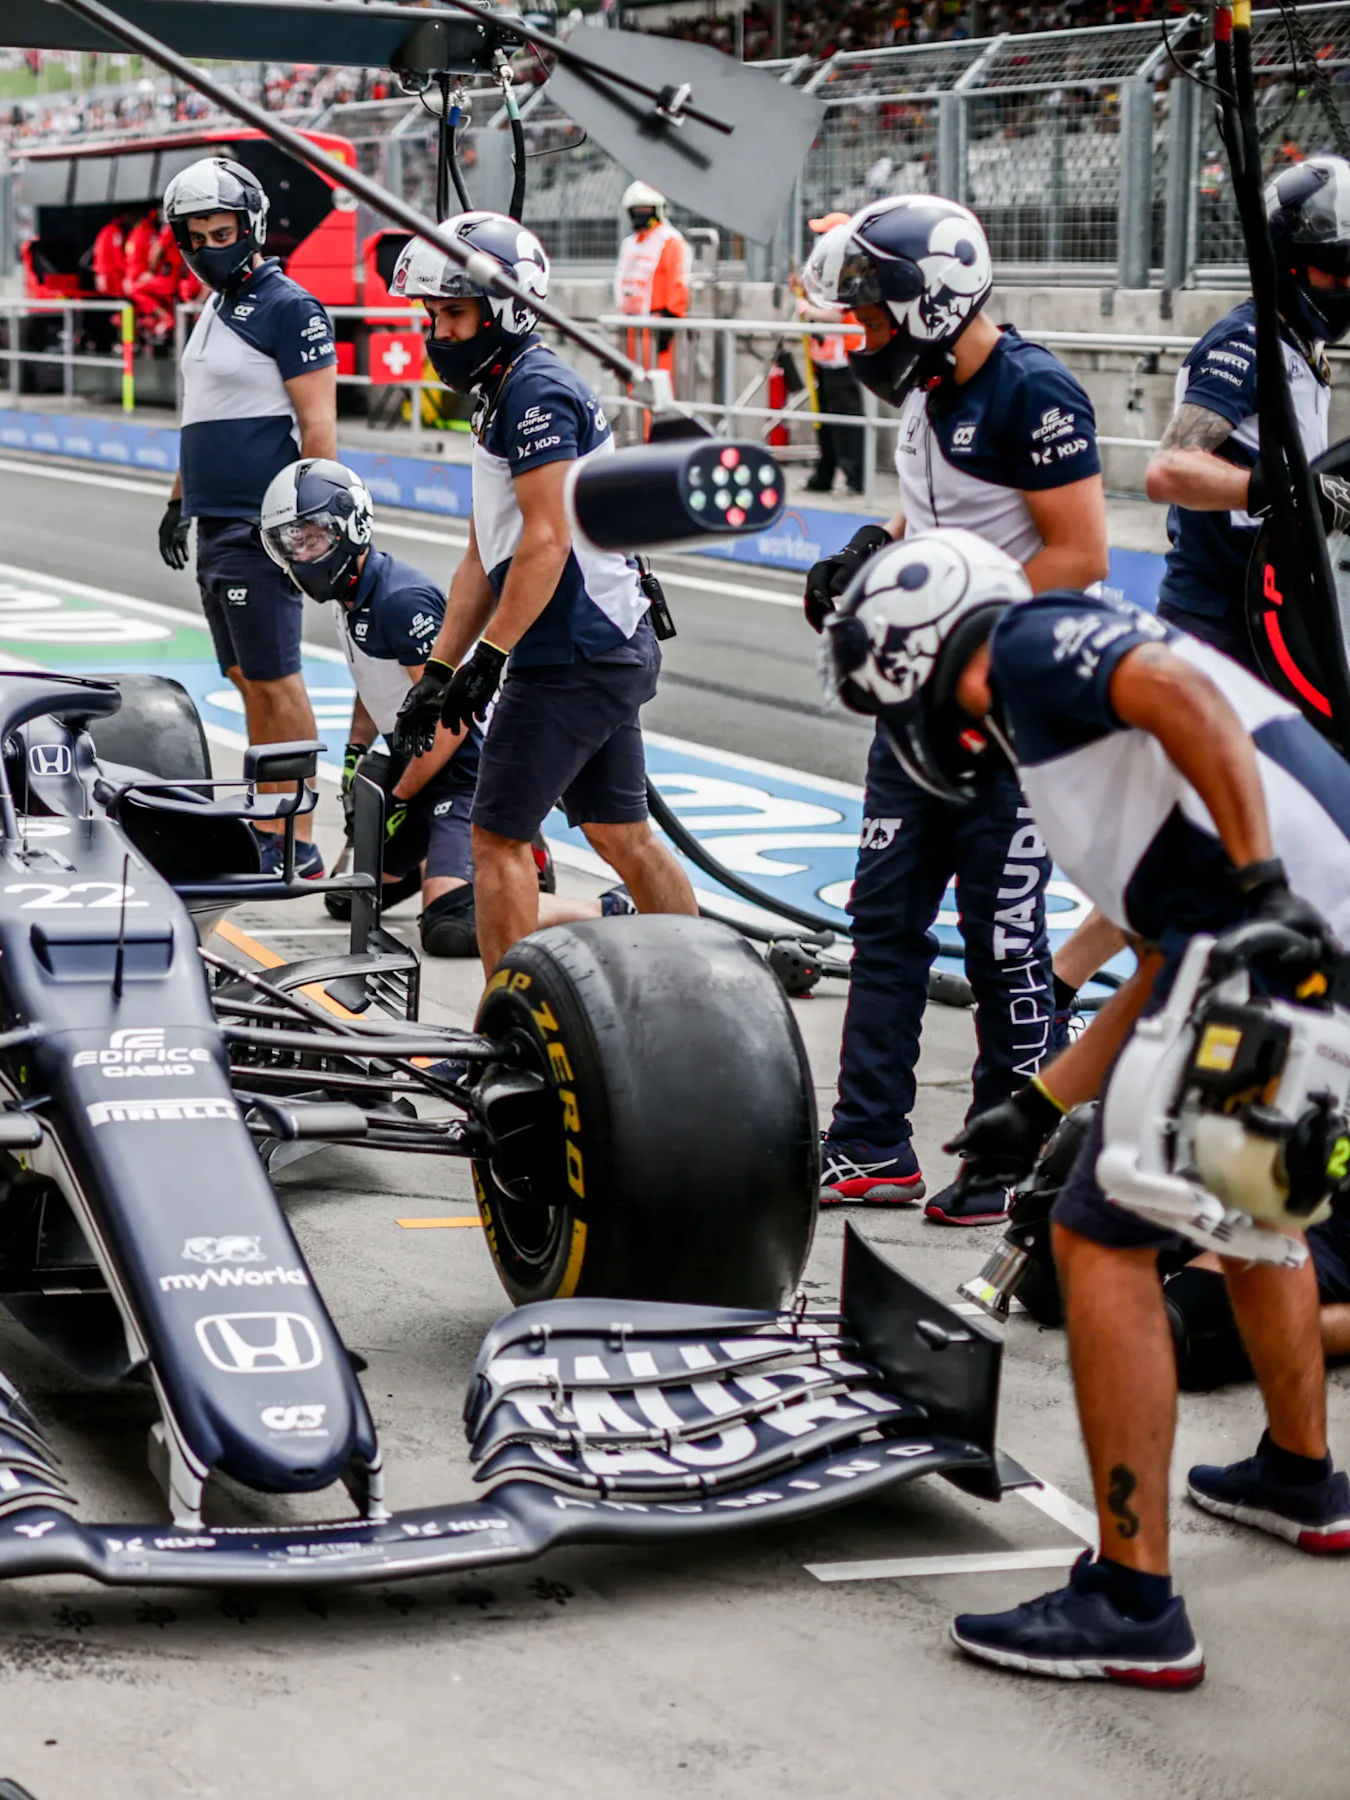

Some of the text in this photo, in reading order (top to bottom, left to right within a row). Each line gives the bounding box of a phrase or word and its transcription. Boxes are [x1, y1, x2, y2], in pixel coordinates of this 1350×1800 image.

[1207, 349, 1250, 372] PIRELLI
[517, 411, 552, 431] EDIFICE
[522, 421, 550, 436] CASIO
[1032, 412, 1075, 441] EDIFICE
[3, 881, 151, 909] 22
[73, 1047, 211, 1068] EDIFICE
[102, 1063, 196, 1078] CASIO
[86, 1097, 239, 1128] PIRELLI
[530, 1001, 587, 1201] ZERO
[158, 1265, 310, 1293] myWorld
[716, 1443, 935, 1509] MIND
